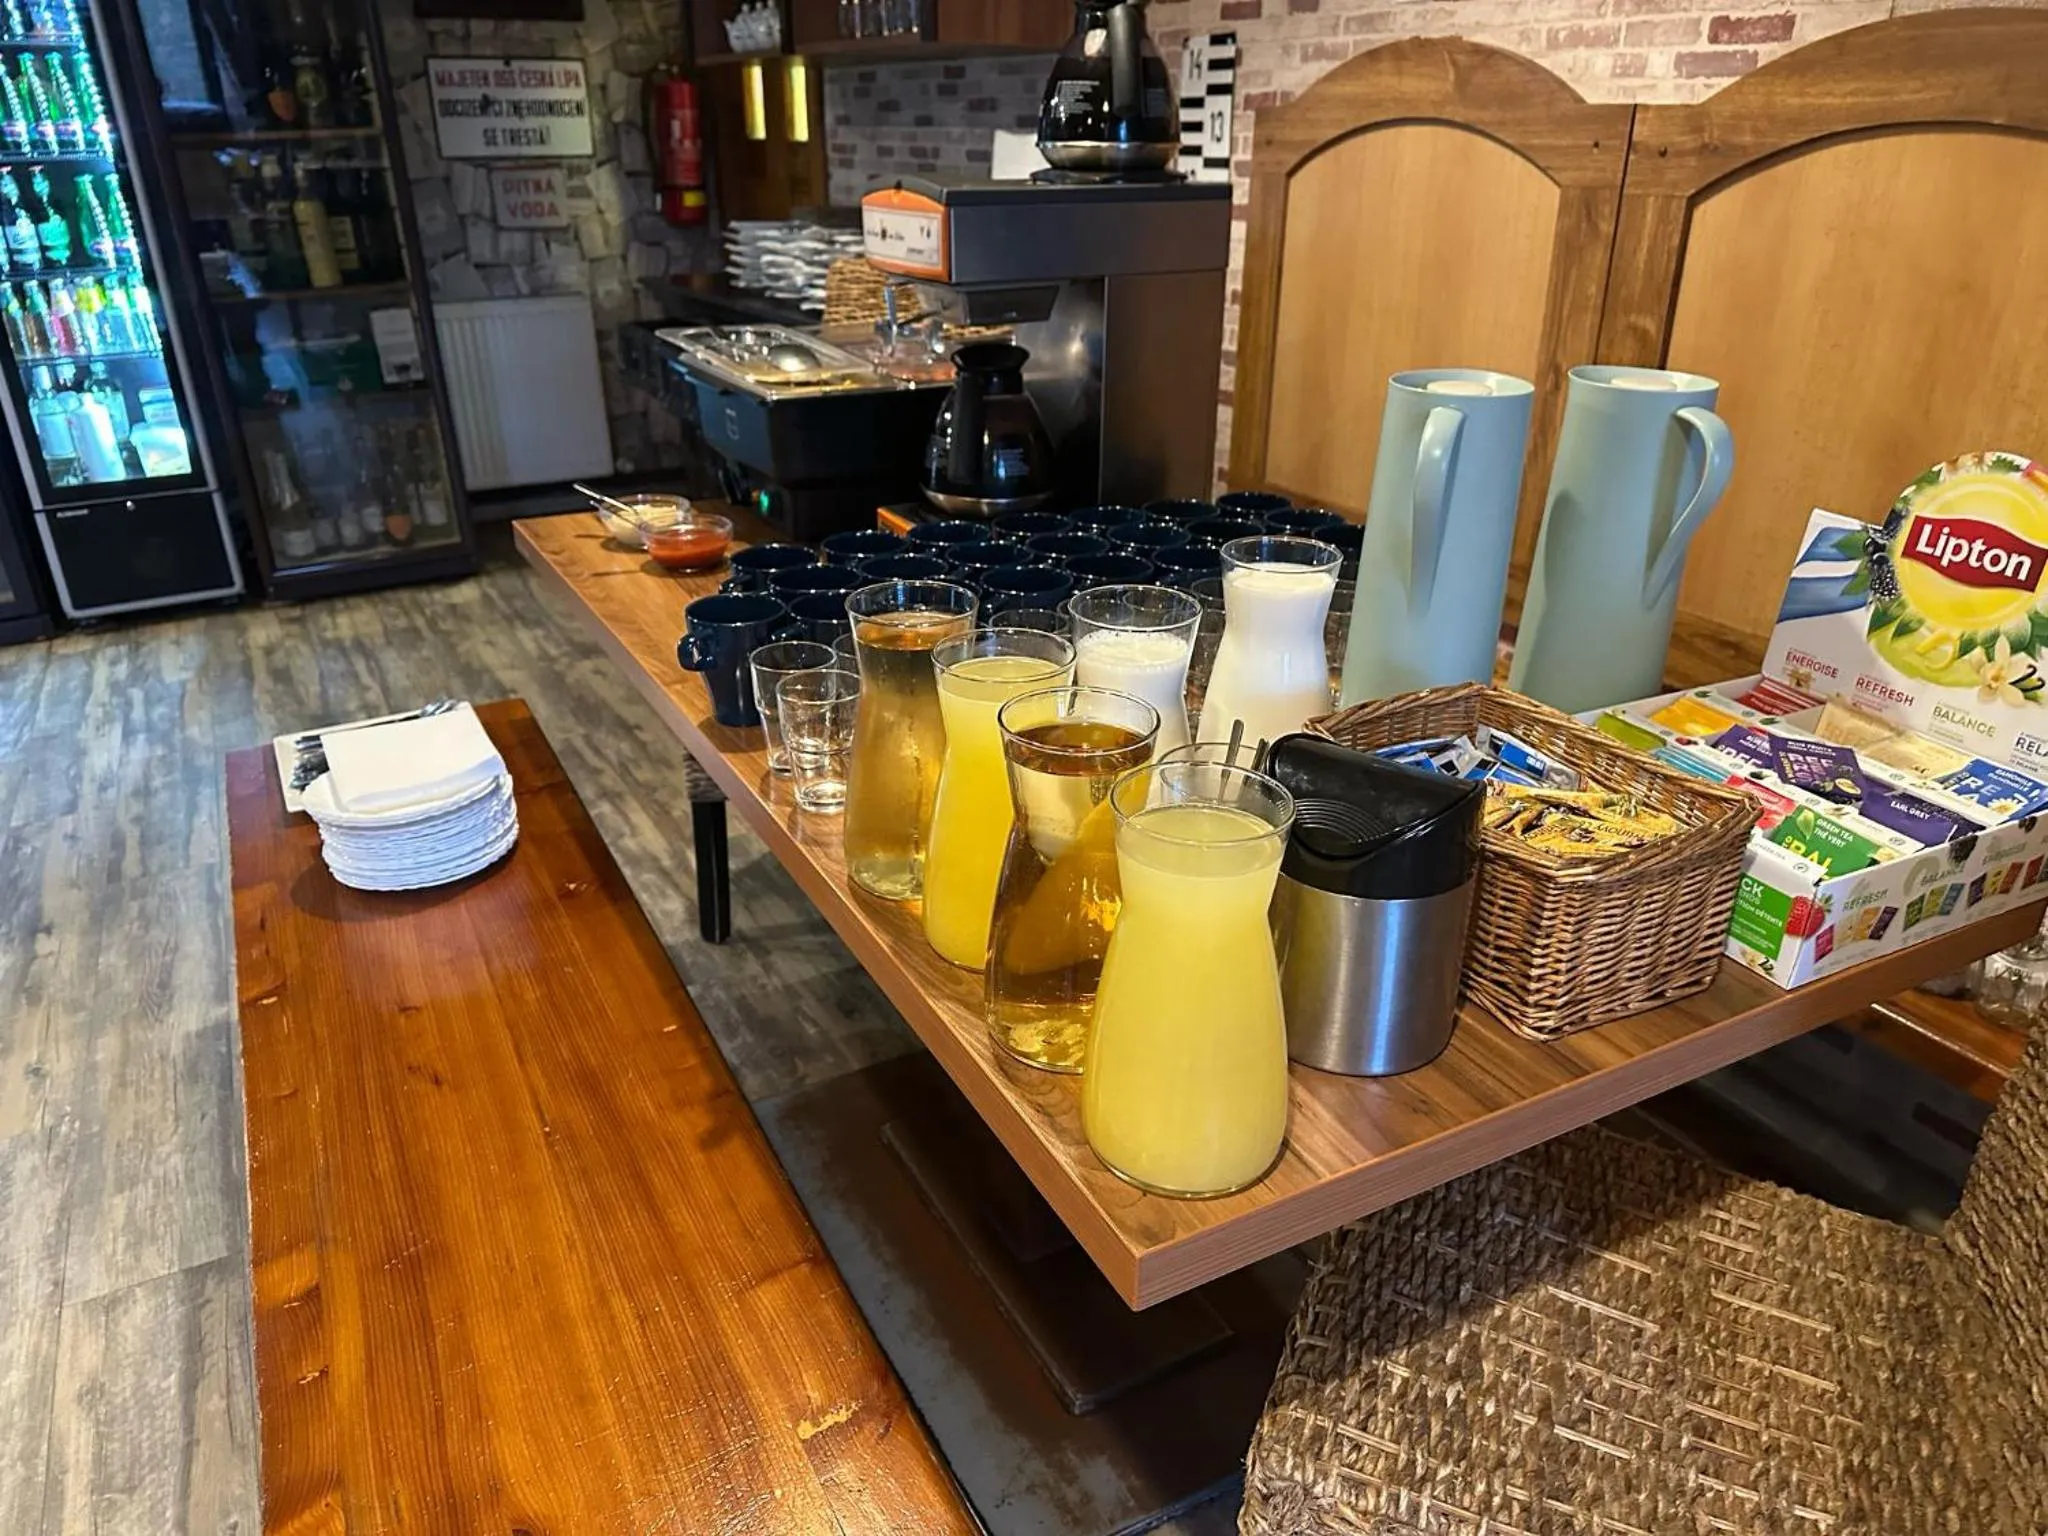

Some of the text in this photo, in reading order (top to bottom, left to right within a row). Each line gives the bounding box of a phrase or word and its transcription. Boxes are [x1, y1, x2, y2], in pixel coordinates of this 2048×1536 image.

[1189, 48, 1202, 80] 14
[1210, 111, 1224, 143] 13
[507, 200, 560, 219] VODA
[1914, 523, 2033, 582] Lipton
[1786, 651, 1840, 679] ENERGISE
[1856, 677, 1915, 707] REFRESH
[1932, 706, 1997, 738] BALANCE
[1890, 801, 1931, 820] EARL GREY
[1816, 818, 1854, 842] GREEN TEA
